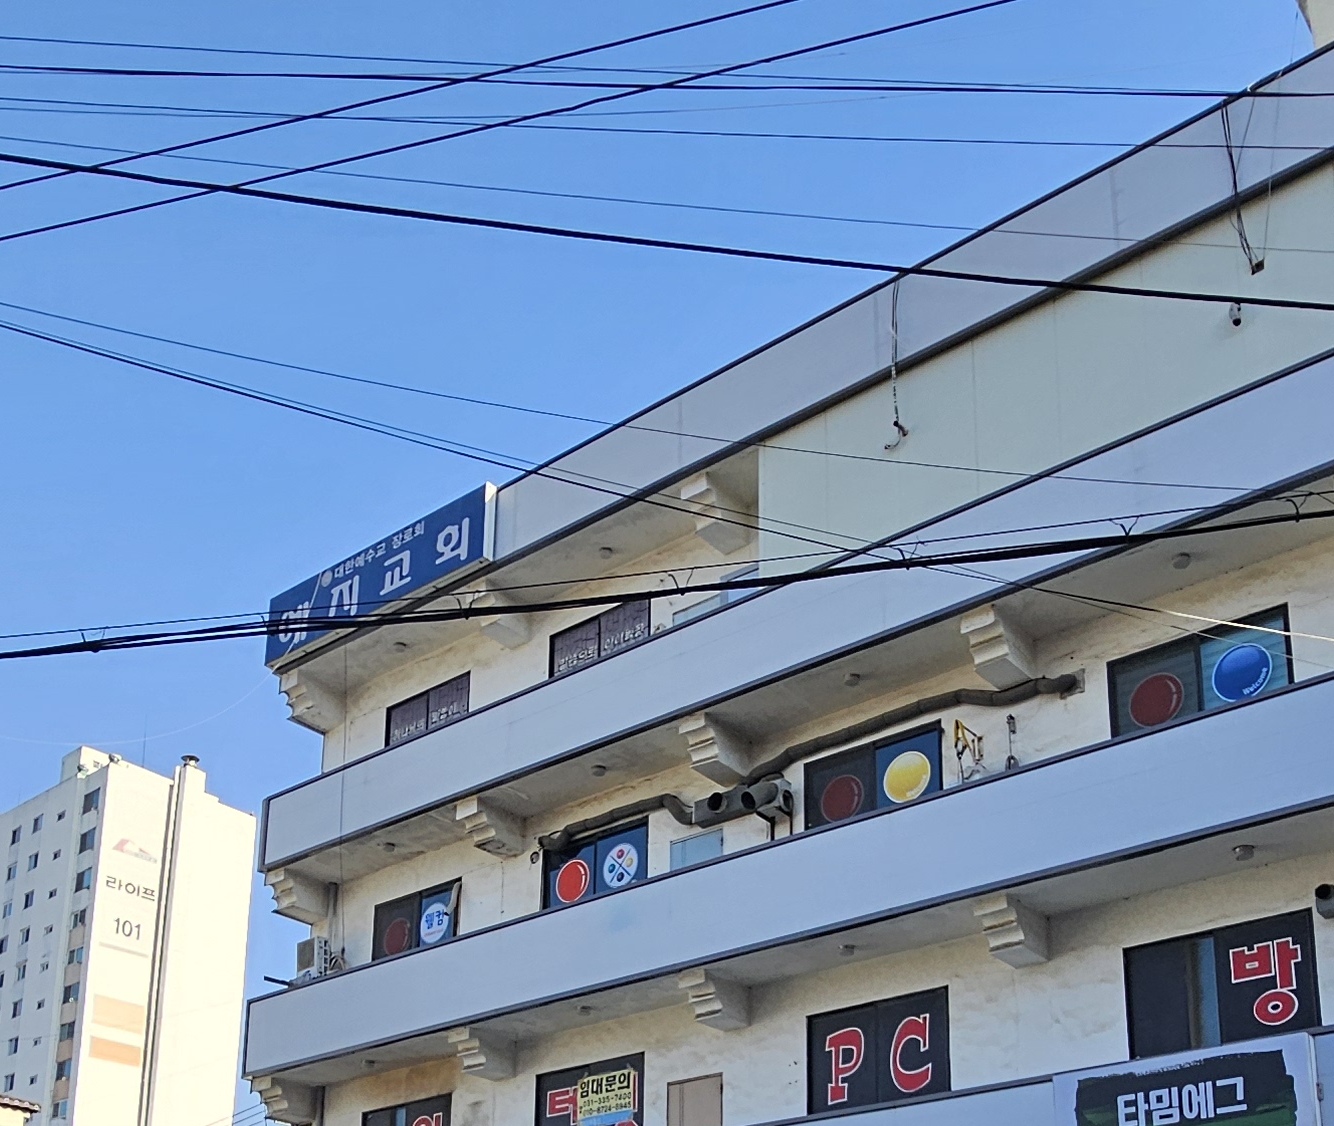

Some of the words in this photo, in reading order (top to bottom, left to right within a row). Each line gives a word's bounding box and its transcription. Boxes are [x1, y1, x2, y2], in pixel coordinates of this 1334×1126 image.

[105, 875, 155, 902] 라이프
[114, 917, 142, 940] 101
[1229, 936, 1302, 1026] 방
[579, 1071, 632, 1098] 임대문의
